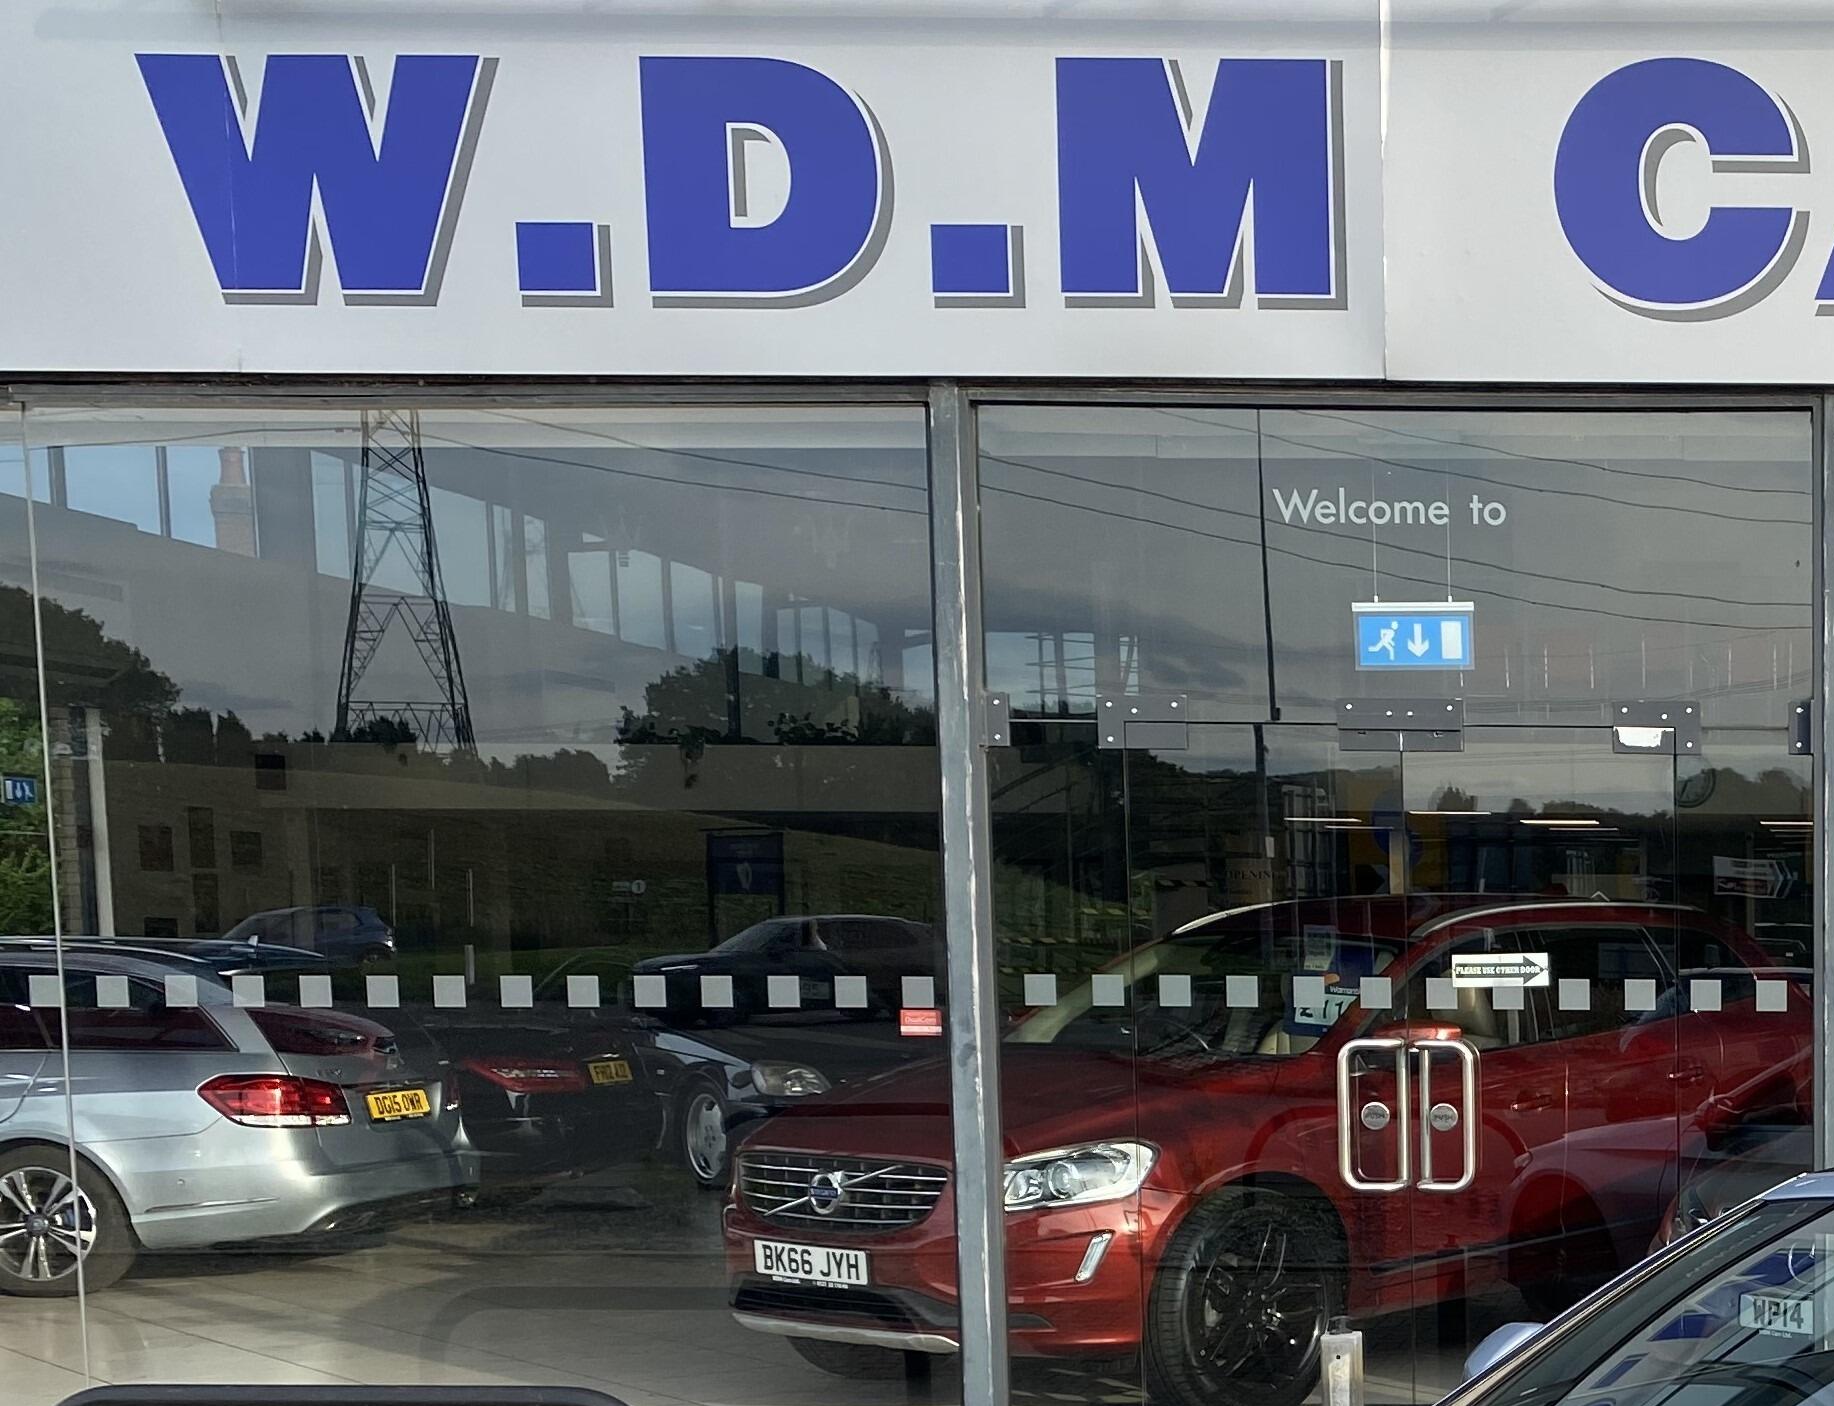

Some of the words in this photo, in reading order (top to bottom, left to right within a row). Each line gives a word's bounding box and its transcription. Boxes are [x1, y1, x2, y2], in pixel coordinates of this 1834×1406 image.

[134, 54, 1347, 310] W.D.M
[1272, 487, 1450, 526] Welcome
[1469, 494, 1507, 526] to
[1456, 966, 1482, 975] PLEASE
[1482, 966, 1495, 975] USE
[1496, 965, 1520, 975] OTHER
[1520, 965, 1541, 974] DOOR
[374, 1095, 402, 1115] DG15
[762, 1244, 813, 1275] BK66
[819, 1251, 860, 1280] JYH
[1752, 1298, 1804, 1330] WP14
